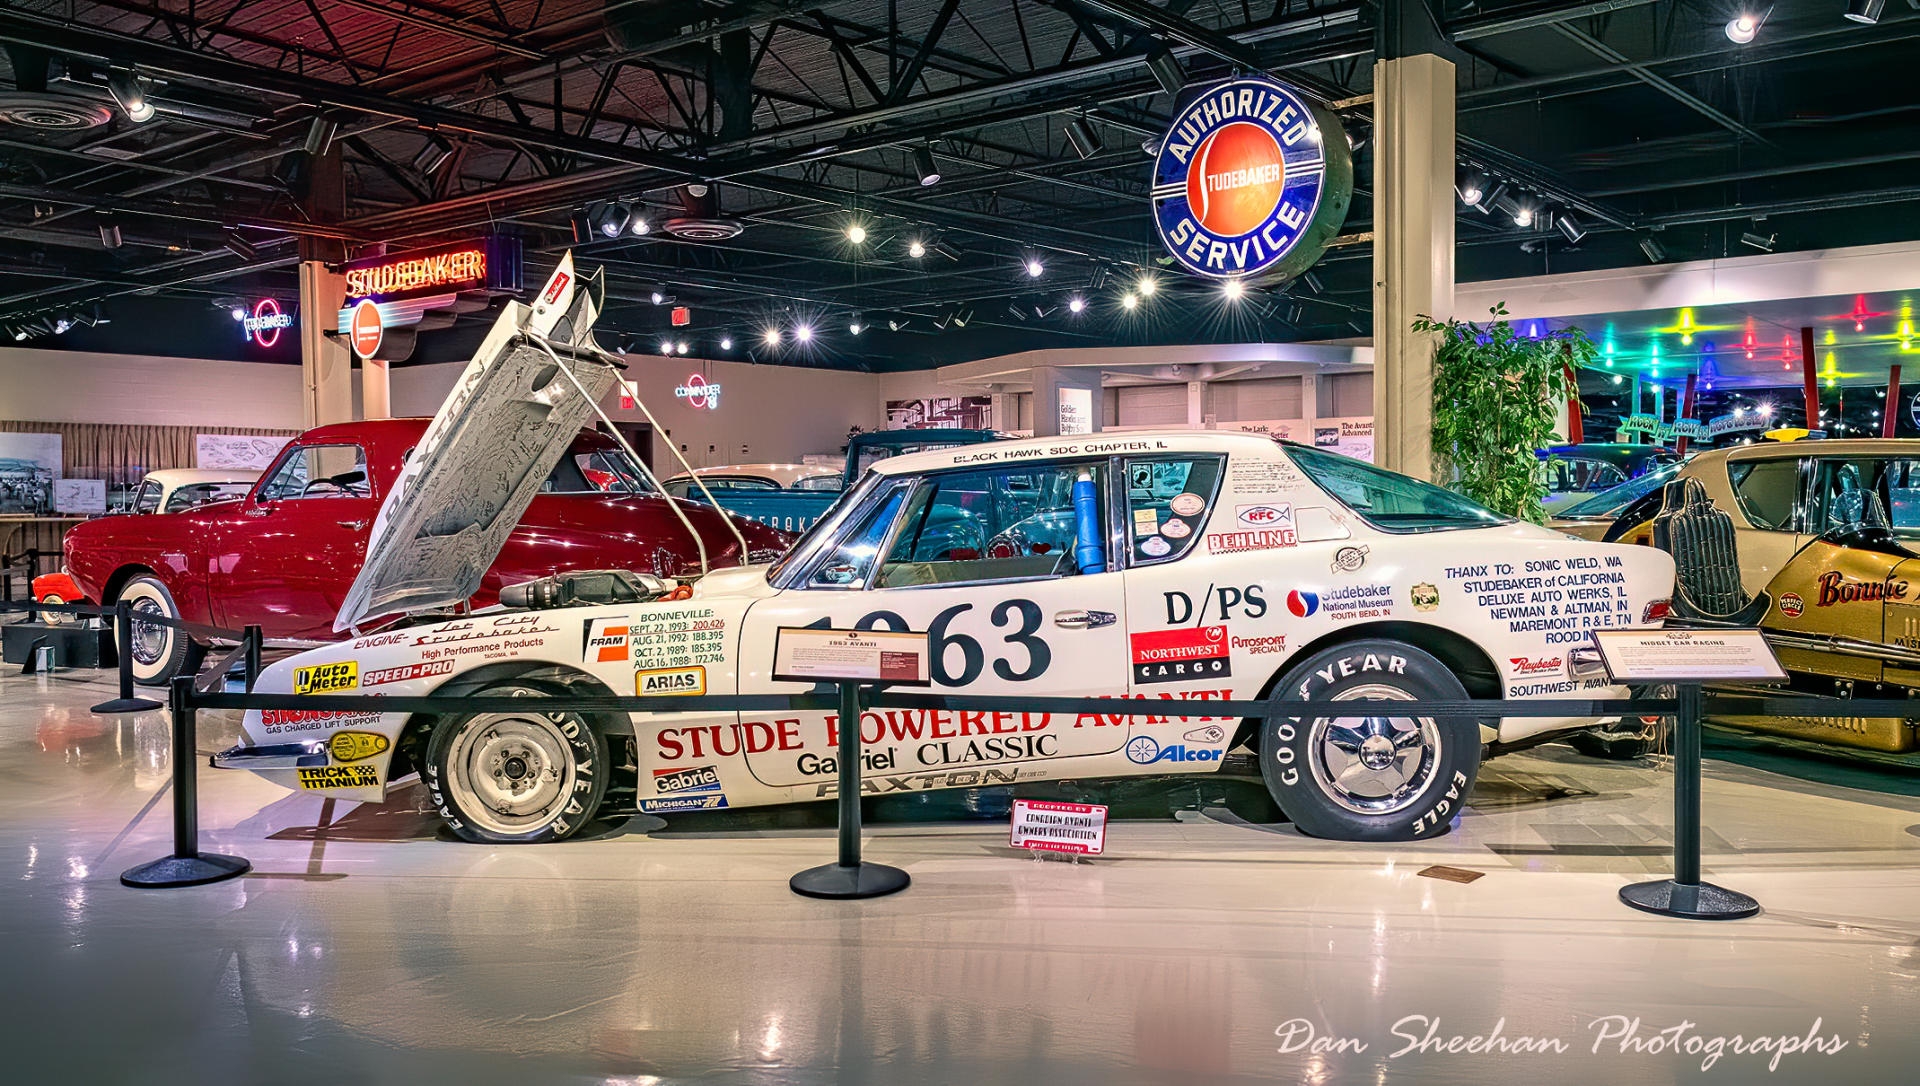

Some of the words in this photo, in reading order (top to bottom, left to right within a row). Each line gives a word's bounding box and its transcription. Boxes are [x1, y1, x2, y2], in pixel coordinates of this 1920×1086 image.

[1169, 89, 1307, 164] AUTHORIZED
[1170, 201, 1305, 269] SERVICE
[346, 250, 479, 297] STUDEBAKER
[1341, 429, 1373, 437] Advanced
[1342, 422, 1354, 430] The
[953, 452, 998, 464] BLACK
[1004, 448, 1043, 459] HAWK
[1049, 445, 1079, 455] SDC
[1085, 442, 1151, 454] CHAPTER,
[1157, 440, 1169, 450] IL
[1249, 511, 1274, 521] RFC
[1208, 530, 1297, 551] BEHLING
[1445, 565, 1488, 579] THANX
[1494, 564, 1514, 576] TO:
[1524, 560, 1561, 573] SONIC
[1565, 558, 1601, 571] WELD,
[1603, 556, 1623, 568] WA
[1464, 577, 1543, 594] STUDEBAKER
[1544, 576, 1556, 589] of
[1557, 572, 1625, 588] CALIFORNIA
[1816, 570, 1908, 607] Bonnie
[1321, 584, 1391, 601] Studebaker
[1478, 592, 1526, 606] DELUXE
[1530, 590, 1563, 604] AUTO
[1566, 587, 1613, 601] WERKS,
[1616, 586, 1627, 598] IL
[1322, 602, 1357, 612] National
[1358, 598, 1393, 609] Museum
[1490, 606, 1546, 620] NEWMAN
[1550, 604, 1559, 617] &
[1564, 602, 1613, 616] ALTMAN,
[1617, 600, 1628, 612] IN
[493, 616, 540, 629] City
[641, 609, 714, 623] BONNEVILLE:
[1331, 611, 1357, 621] SOUTH
[1359, 610, 1381, 619] BEND,
[1383, 608, 1391, 617] IN
[1509, 617, 1579, 633] MAREMONT
[1583, 616, 1592, 629] R
[1594, 616, 1602, 628] &
[1604, 615, 1614, 628] E,
[1616, 613, 1632, 627] TN
[629, 624, 653, 635] SEPT.
[655, 622, 668, 633] 22,
[669, 619, 691, 632] 1993:
[693, 619, 726, 630] 200.426
[354, 633, 409, 650] ENGINE-
[409, 627, 560, 647] Studebaker
[590, 636, 624, 647] FRAM
[632, 634, 654, 647] AUG.
[656, 633, 667, 644] 21,
[669, 631, 690, 643] 1992:
[693, 630, 724, 641] 188.395
[1231, 636, 1286, 649] AUTOSPORT
[1546, 631, 1582, 645] ROOD
[421, 649, 441, 660] High
[444, 644, 501, 658] Performance
[503, 637, 544, 651] Products
[634, 646, 653, 658] OCT.
[657, 645, 666, 656] 2,
[667, 643, 689, 656] 1989:
[691, 642, 722, 654] 185.395
[1140, 644, 1221, 661] NORTHWEST
[1250, 645, 1286, 655] SPECIALTY
[633, 657, 654, 670] AUG.
[656, 656, 669, 668] 16,
[670, 654, 692, 667] 1988:
[695, 653, 725, 665] 172.746
[1142, 660, 1222, 677] CARGO
[1510, 657, 1562, 673] Raybestos
[312, 664, 350, 680] Auto
[363, 660, 454, 687] SPEED-PRO
[310, 674, 357, 692] Meter
[646, 673, 696, 690] ARIAS
[1509, 681, 1580, 697] SOUTHWEST
[1583, 677, 1609, 690] AVAN
[266, 726, 281, 734] GAS
[284, 721, 322, 733] CHARGED
[324, 718, 341, 729] LIFT
[344, 713, 382, 726] SUPPORT
[1277, 653, 1408, 786] GOOYEAR
[656, 718, 805, 760] STUDE
[917, 734, 1058, 766] CLASSIC
[1159, 744, 1224, 763] Alcor
[298, 767, 350, 778] TRICK
[655, 767, 719, 792] Gabriel
[301, 776, 379, 789] TITANIUM
[427, 763, 464, 831] EAGLE
[646, 799, 702, 810] MICHIGAN
[701, 796, 722, 808] 77
[1413, 770, 1466, 835] EAGLE
[1033, 803, 1075, 811] ADOPTED
[1025, 813, 1062, 825] CANADIAN
[1064, 816, 1092, 828] AVANTI
[1018, 825, 1047, 837] OWNERS
[1049, 827, 1098, 840] ASSOCIATION
